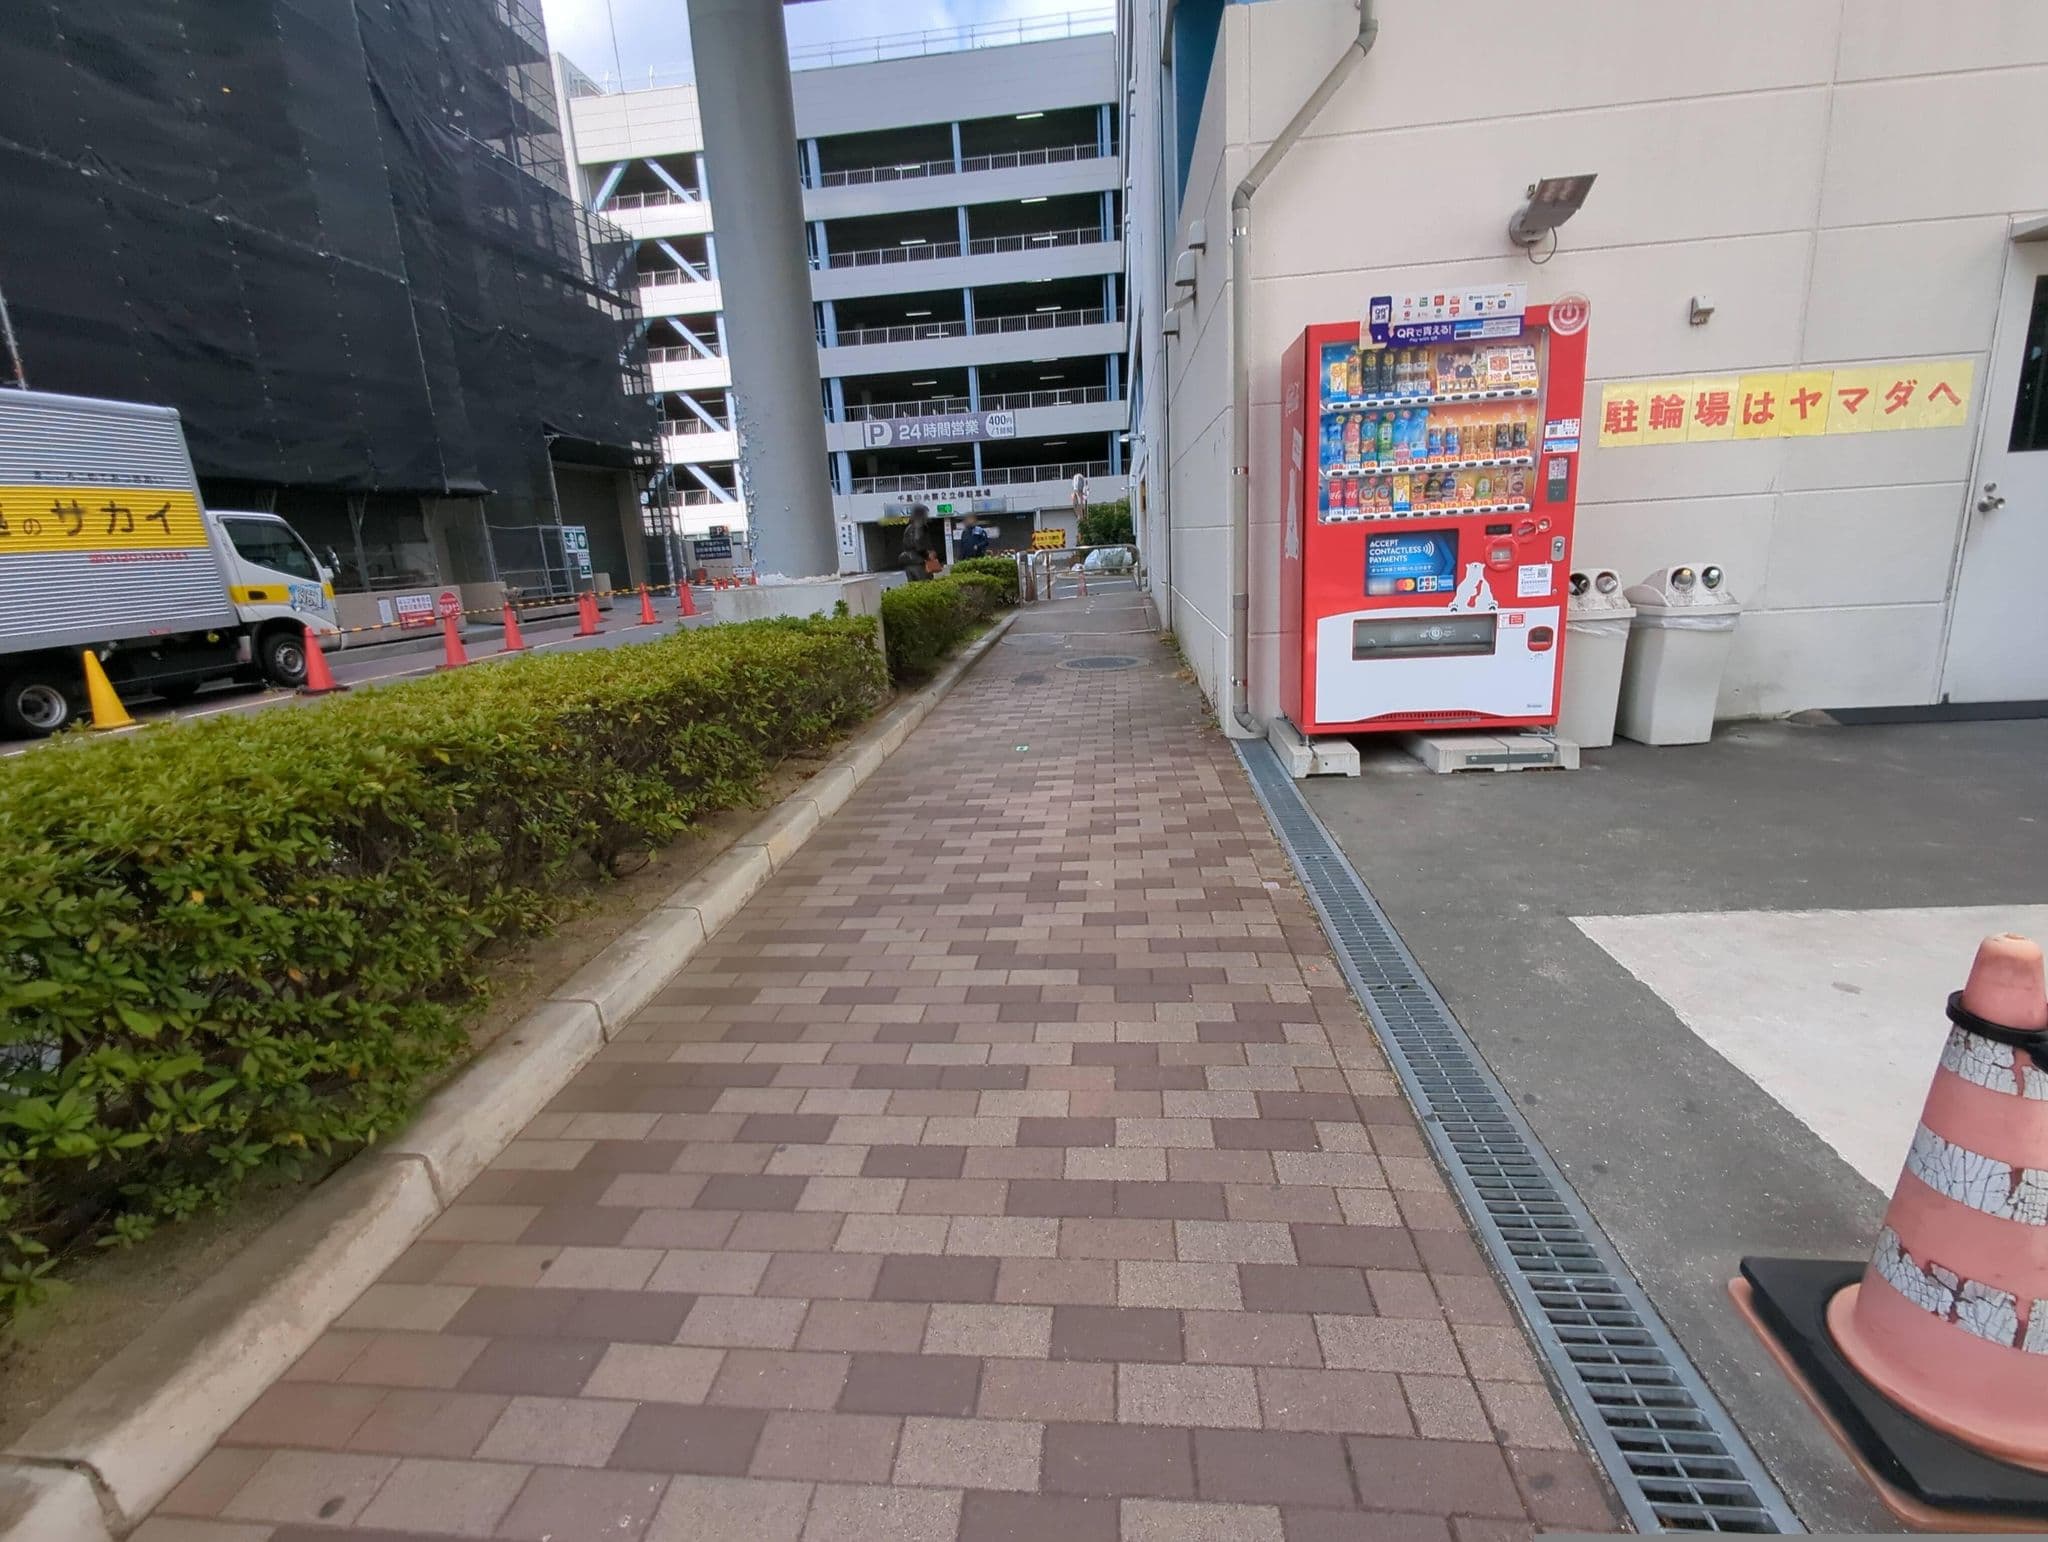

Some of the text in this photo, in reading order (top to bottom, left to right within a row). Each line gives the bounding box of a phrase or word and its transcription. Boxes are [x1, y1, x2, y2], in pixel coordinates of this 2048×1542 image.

[1603, 379, 1962, 434] 駐輪場はヤマダへ
[869, 423, 885, 445] P
[899, 420, 979, 440] 24時間営業
[1369, 539, 1399, 548] ACCEPT
[1369, 546, 1422, 556] CONTACTLESS
[1369, 555, 1408, 564] PAYMENTS
